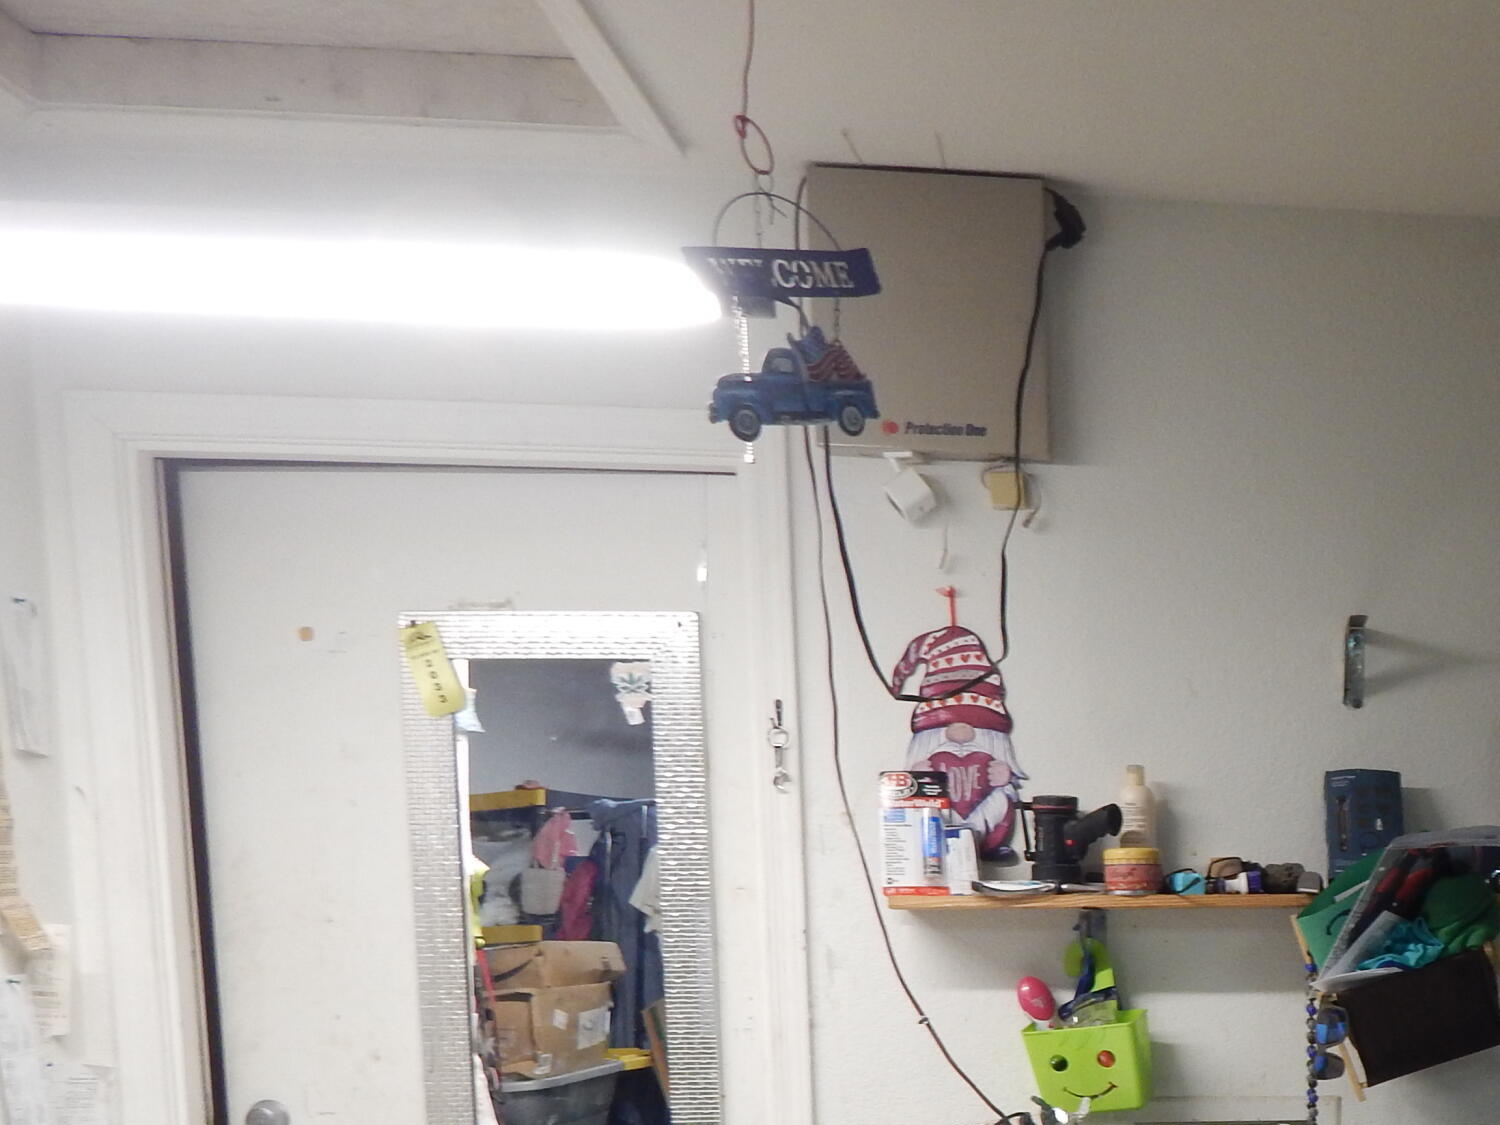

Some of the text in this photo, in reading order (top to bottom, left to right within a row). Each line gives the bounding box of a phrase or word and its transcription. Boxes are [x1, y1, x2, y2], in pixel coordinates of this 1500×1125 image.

[707, 257, 855, 289] COME
[904, 421, 987, 437] Protection One
